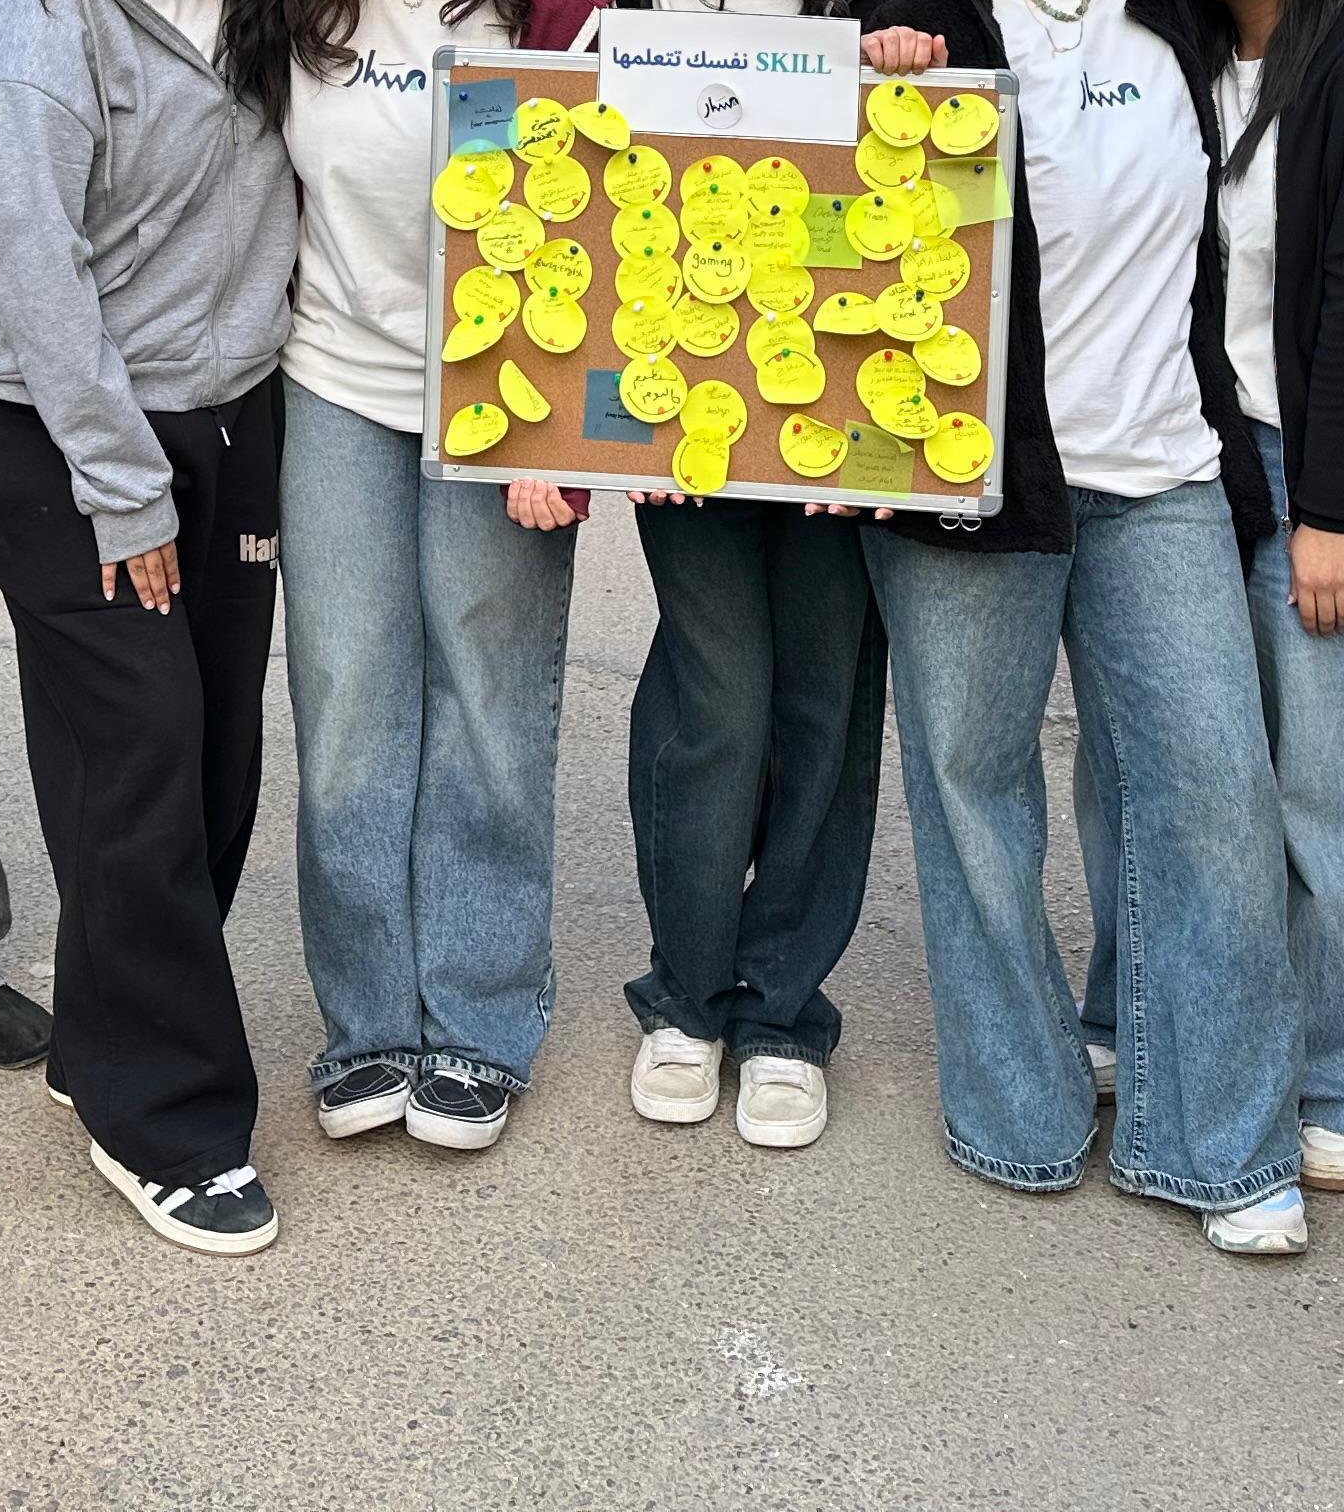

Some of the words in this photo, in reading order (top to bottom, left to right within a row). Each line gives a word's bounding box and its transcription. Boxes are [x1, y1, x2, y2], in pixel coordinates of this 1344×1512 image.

[612, 46, 683, 69] تتعلمها
[686, 51, 749, 70] نفسك
[755, 52, 832, 75] SKILL
[691, 252, 733, 278] gaming
